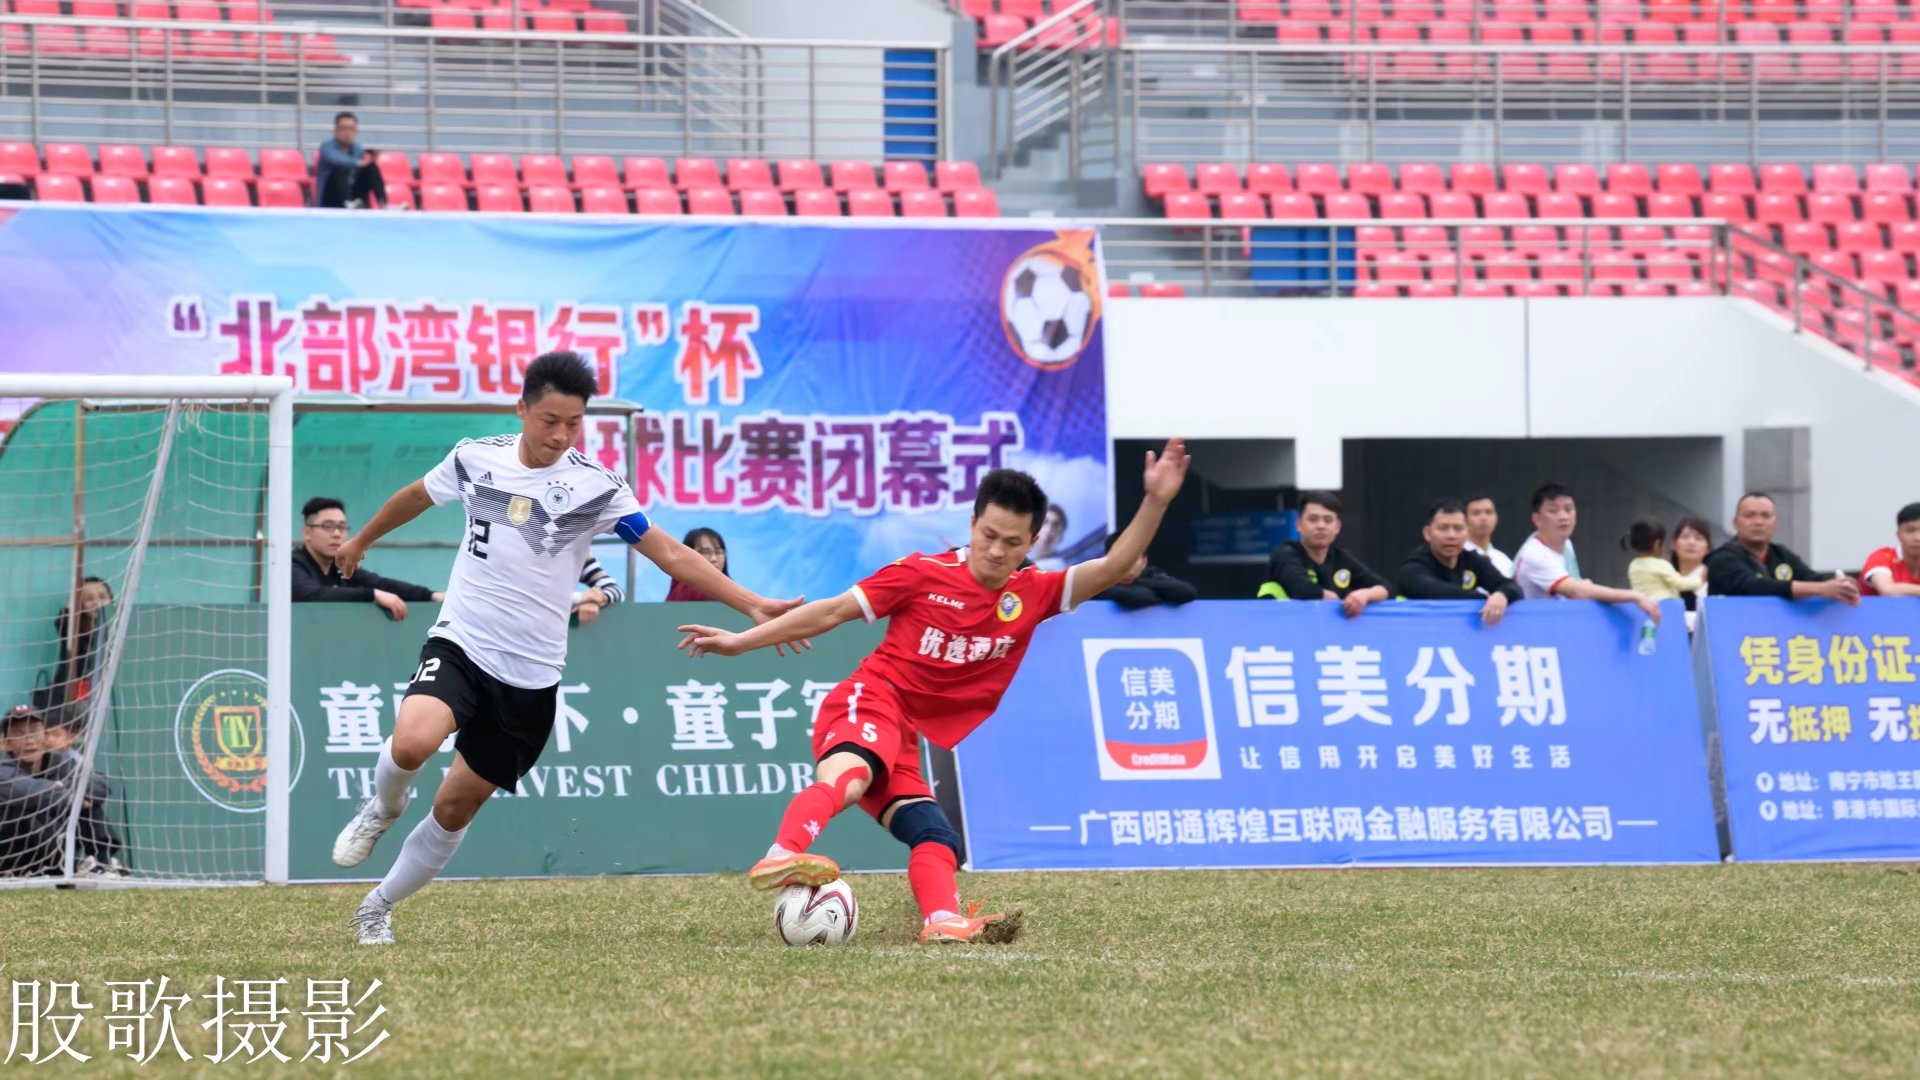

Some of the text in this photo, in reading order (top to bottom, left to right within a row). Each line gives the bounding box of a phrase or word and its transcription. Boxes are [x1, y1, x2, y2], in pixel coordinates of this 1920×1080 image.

[576, 413, 1020, 513] 球比赛闭幕式
[927, 592, 967, 610] KELME
[1740, 634, 1920, 685] 凭身份证
[1120, 667, 1176, 697] 信美
[1225, 645, 1568, 729] 信美分期
[861, 722, 879, 743] 5
[1125, 701, 1181, 731] 分期
[1749, 699, 1852, 744] 无抵押
[1239, 745, 1573, 770] 让信用开启美好生活
[656, 763, 814, 796] CHILDR
[1079, 806, 1614, 847] 广西明通辉煌互联网金融服务有限公司
